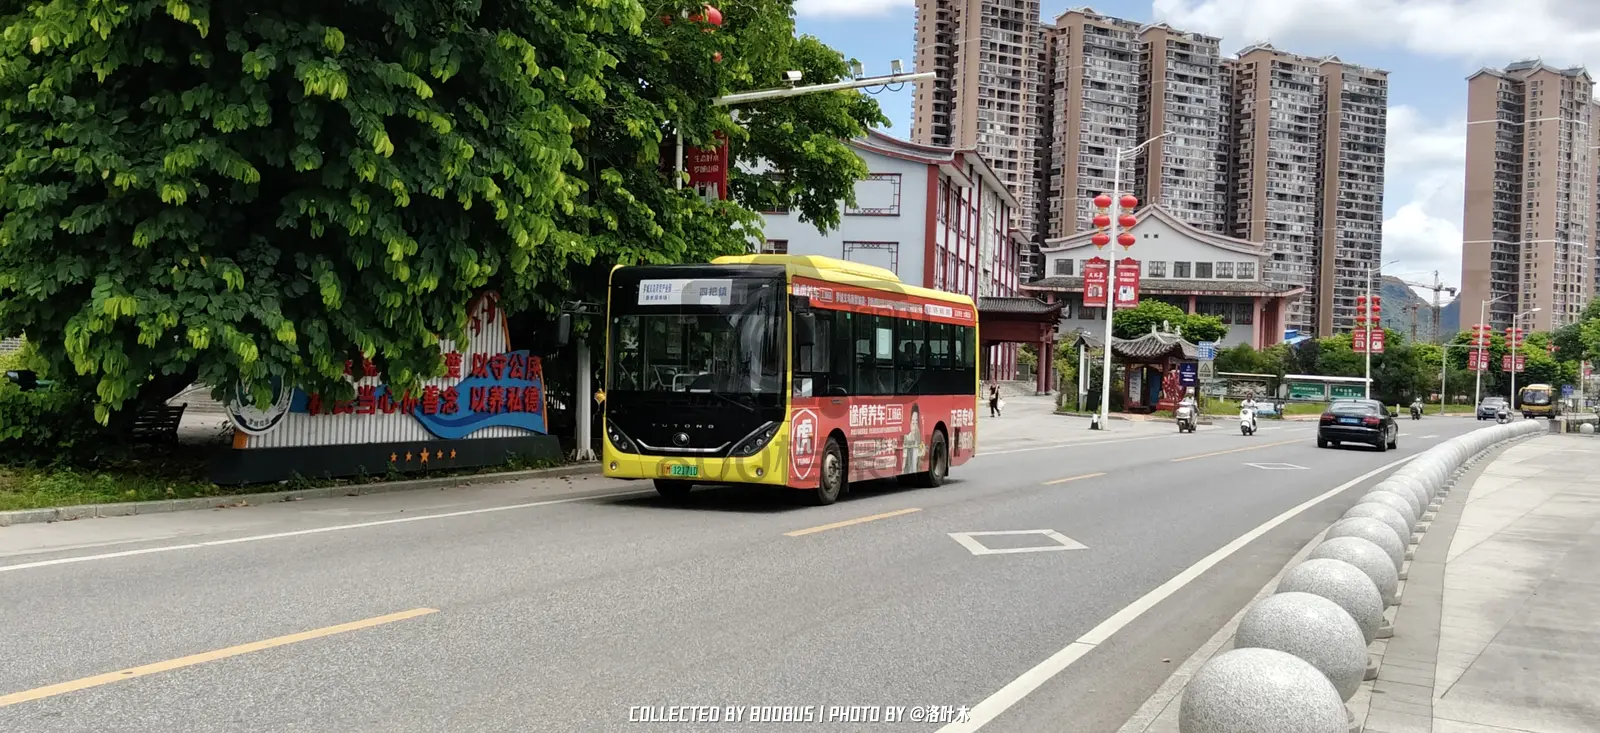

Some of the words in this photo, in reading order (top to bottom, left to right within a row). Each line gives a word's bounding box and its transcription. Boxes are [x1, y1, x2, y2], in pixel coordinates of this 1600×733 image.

[699, 286, 727, 297] 四把镇
[471, 385, 541, 413] 以养私德
[849, 404, 886, 427] 途虎养车
[950, 408, 974, 428] 正品专业
[796, 419, 814, 455] 虎
